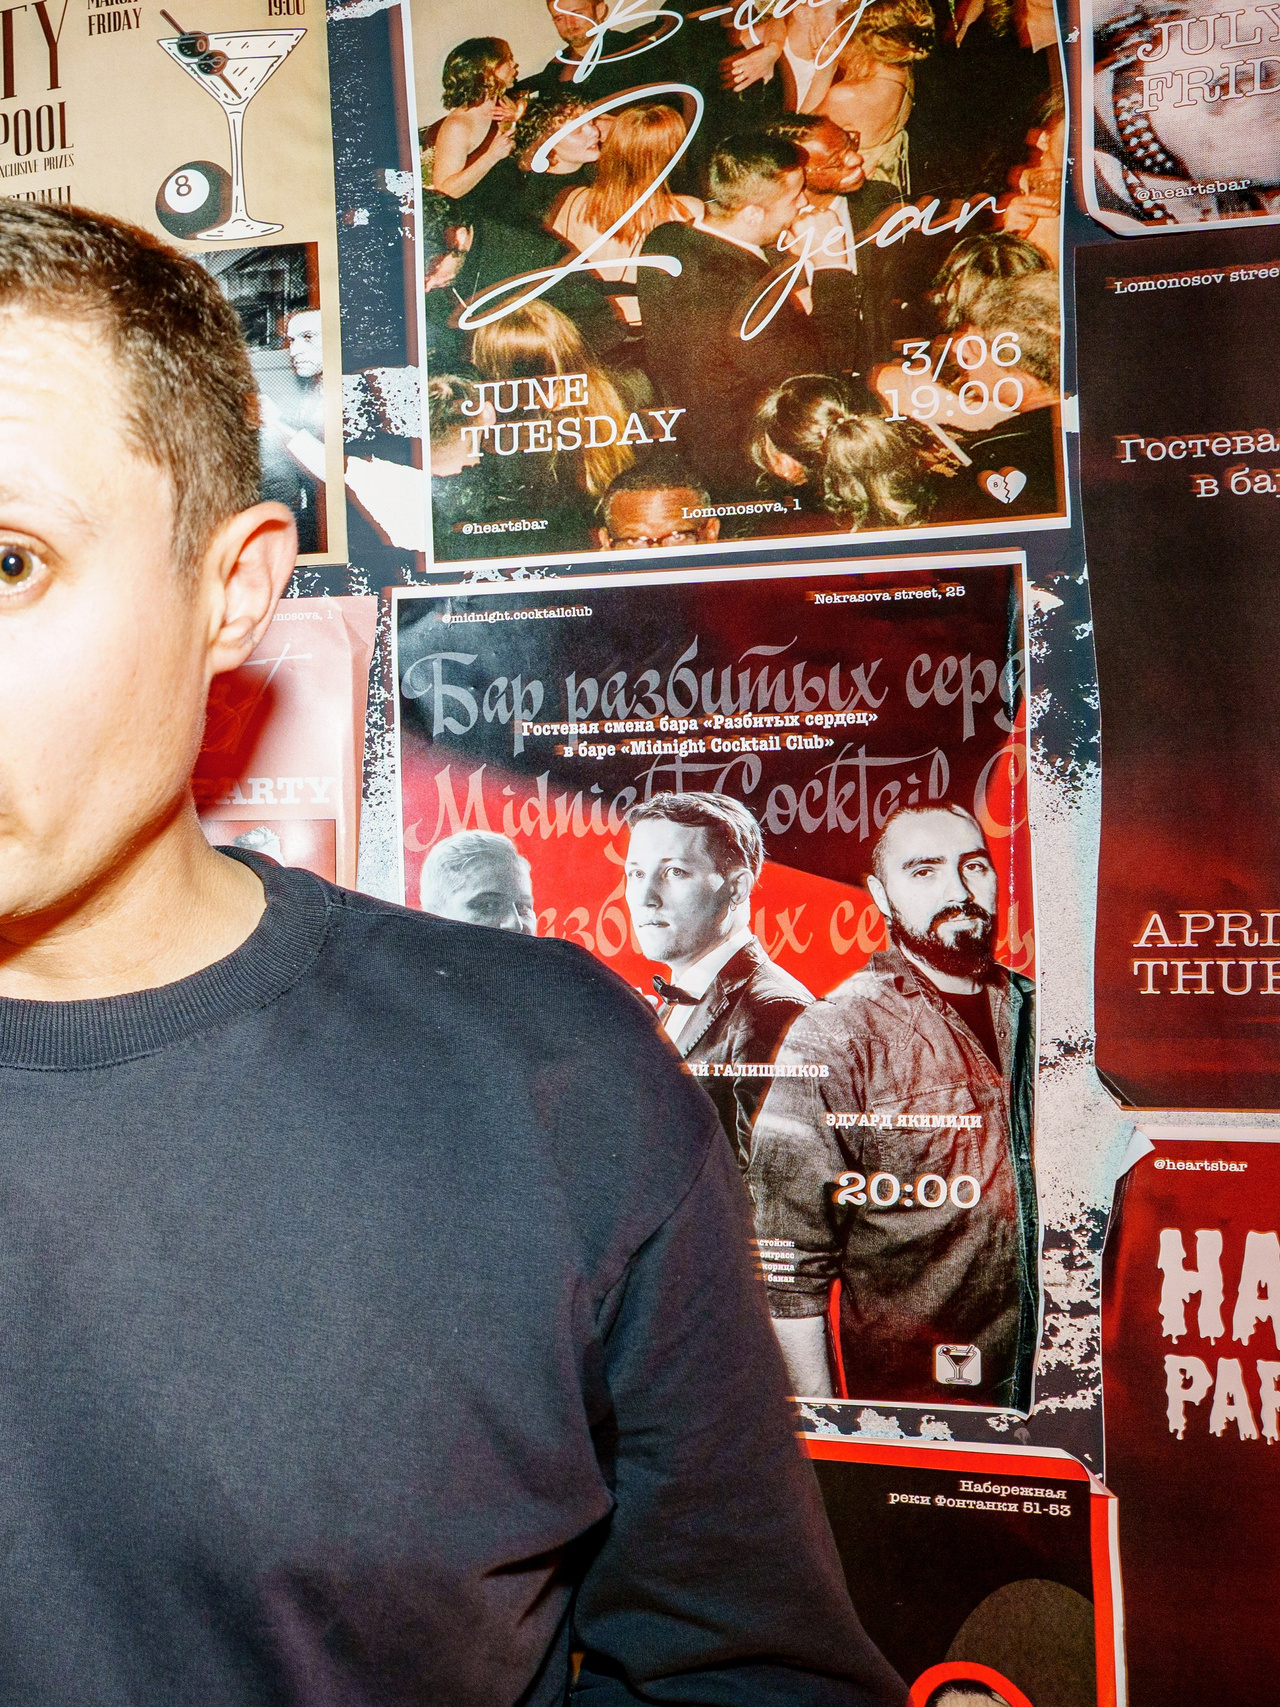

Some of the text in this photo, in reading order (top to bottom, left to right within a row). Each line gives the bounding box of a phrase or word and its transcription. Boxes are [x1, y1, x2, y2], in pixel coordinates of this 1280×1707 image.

[88, 8, 142, 36] FRIDAY
[43, 153, 75, 172] PRIZES
[1137, 178, 1251, 201] @heartsbar
[459, 83, 1007, 341] 2 year
[1114, 267, 1280, 294] Lomonosov stree
[900, 332, 1022, 383] 3/06
[460, 373, 589, 417] JUNE
[884, 377, 1023, 424] 19:00
[460, 408, 686, 458] TUESDAY
[1120, 433, 1280, 463] Гостева
[1230, 467, 1280, 498] ба
[682, 499, 802, 519] Lomonosova, 1
[462, 518, 549, 535] @heartsbar
[814, 585, 966, 605] Nekrasova street, 25
[442, 606, 593, 624] @midnight.cocktailclub
[401, 651, 545, 758] Бар
[565, 634, 889, 756] разбитых
[521, 712, 878, 737] Гостевая смена бара «Разбитых сердец»
[564, 734, 834, 760] в баре «Midnight Cocktail Club»
[1133, 913, 1280, 947] APRI
[713, 1064, 829, 1078] ГАЛИШНИКОВ
[826, 1114, 982, 1130] ЭДУАРД ЯКИМИДИ
[1154, 1158, 1248, 1172] @heartsbar
[837, 1172, 981, 1208] 20:00
[757, 1238, 795, 1247] стойки:
[960, 1480, 1067, 1500] Набережная
[889, 1492, 1071, 1517] реки Фонтанки 51-53
